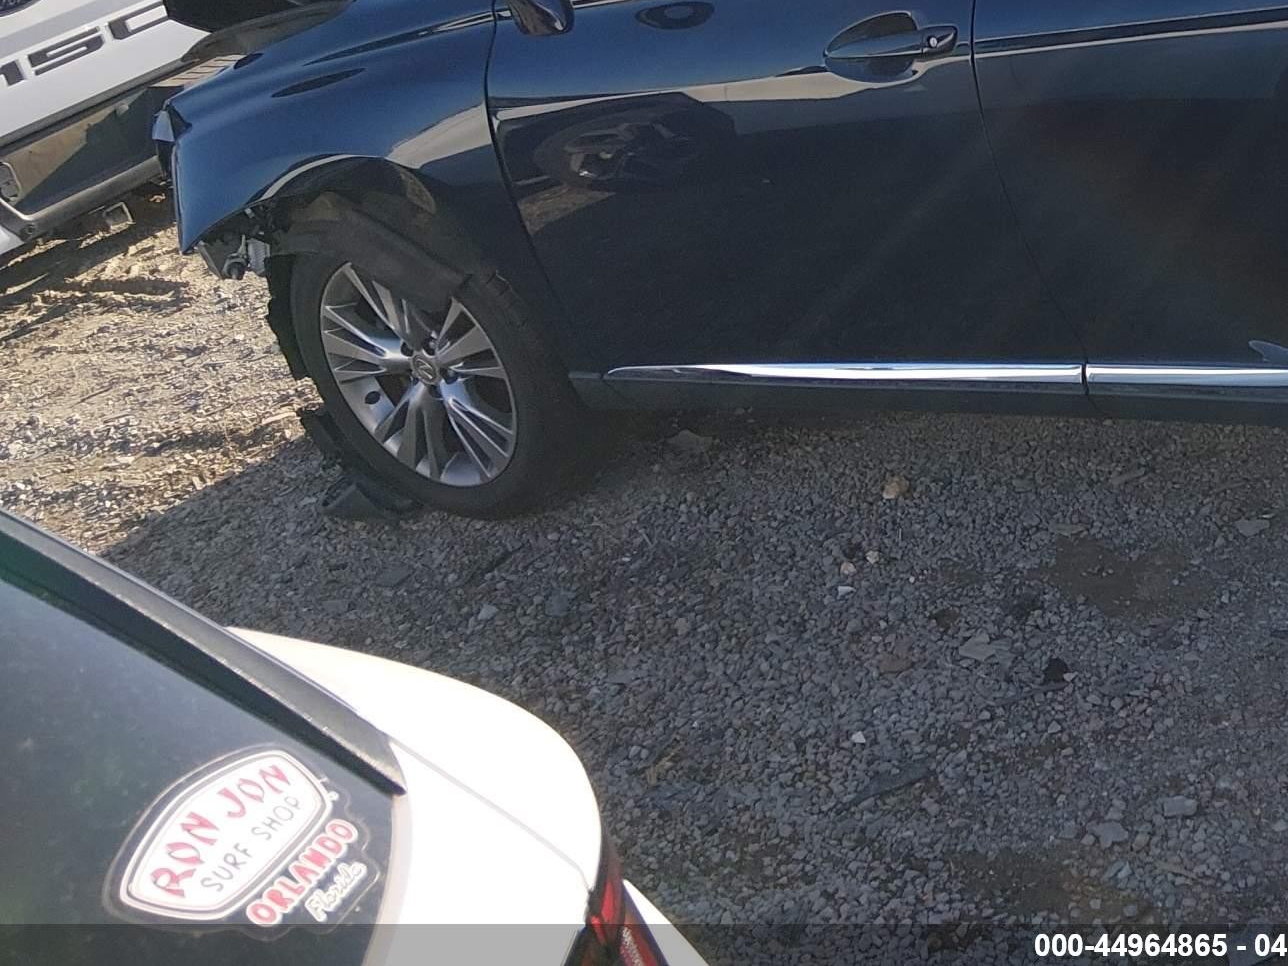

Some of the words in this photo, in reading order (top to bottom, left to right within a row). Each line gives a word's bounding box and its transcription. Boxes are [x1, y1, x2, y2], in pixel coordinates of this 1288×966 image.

[151, 811, 220, 898] RON
[216, 764, 293, 819] JON
[201, 842, 254, 893] SURF
[250, 795, 303, 841] SHOP
[247, 819, 357, 926] ORLANDO
